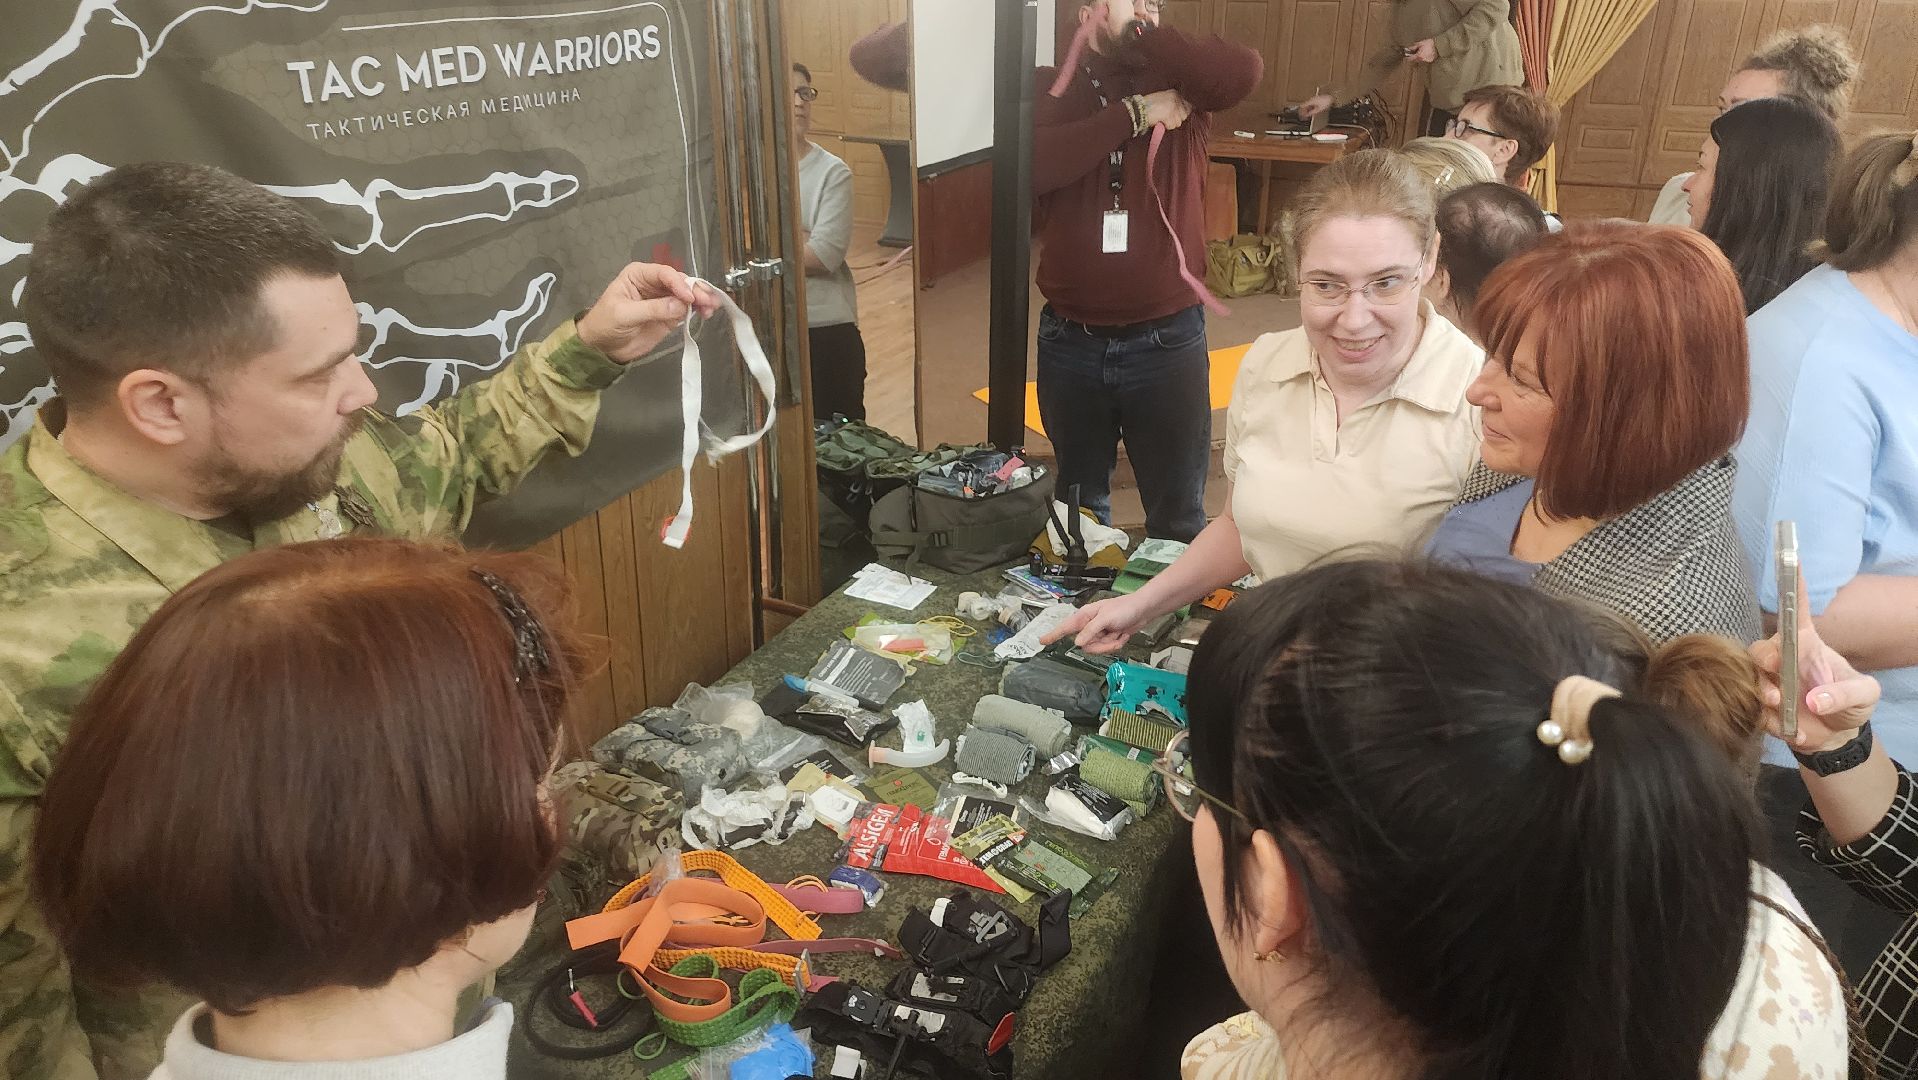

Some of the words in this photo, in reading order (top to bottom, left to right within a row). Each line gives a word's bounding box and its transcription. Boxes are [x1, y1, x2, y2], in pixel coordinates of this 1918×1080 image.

[286, 55, 385, 103] TAC
[395, 45, 487, 92] MED
[493, 24, 662, 79] WARRIORS
[306, 101, 470, 140] ТАКТИЧЕСКАЯ
[481, 87, 581, 114] МЕДИЦИНА
